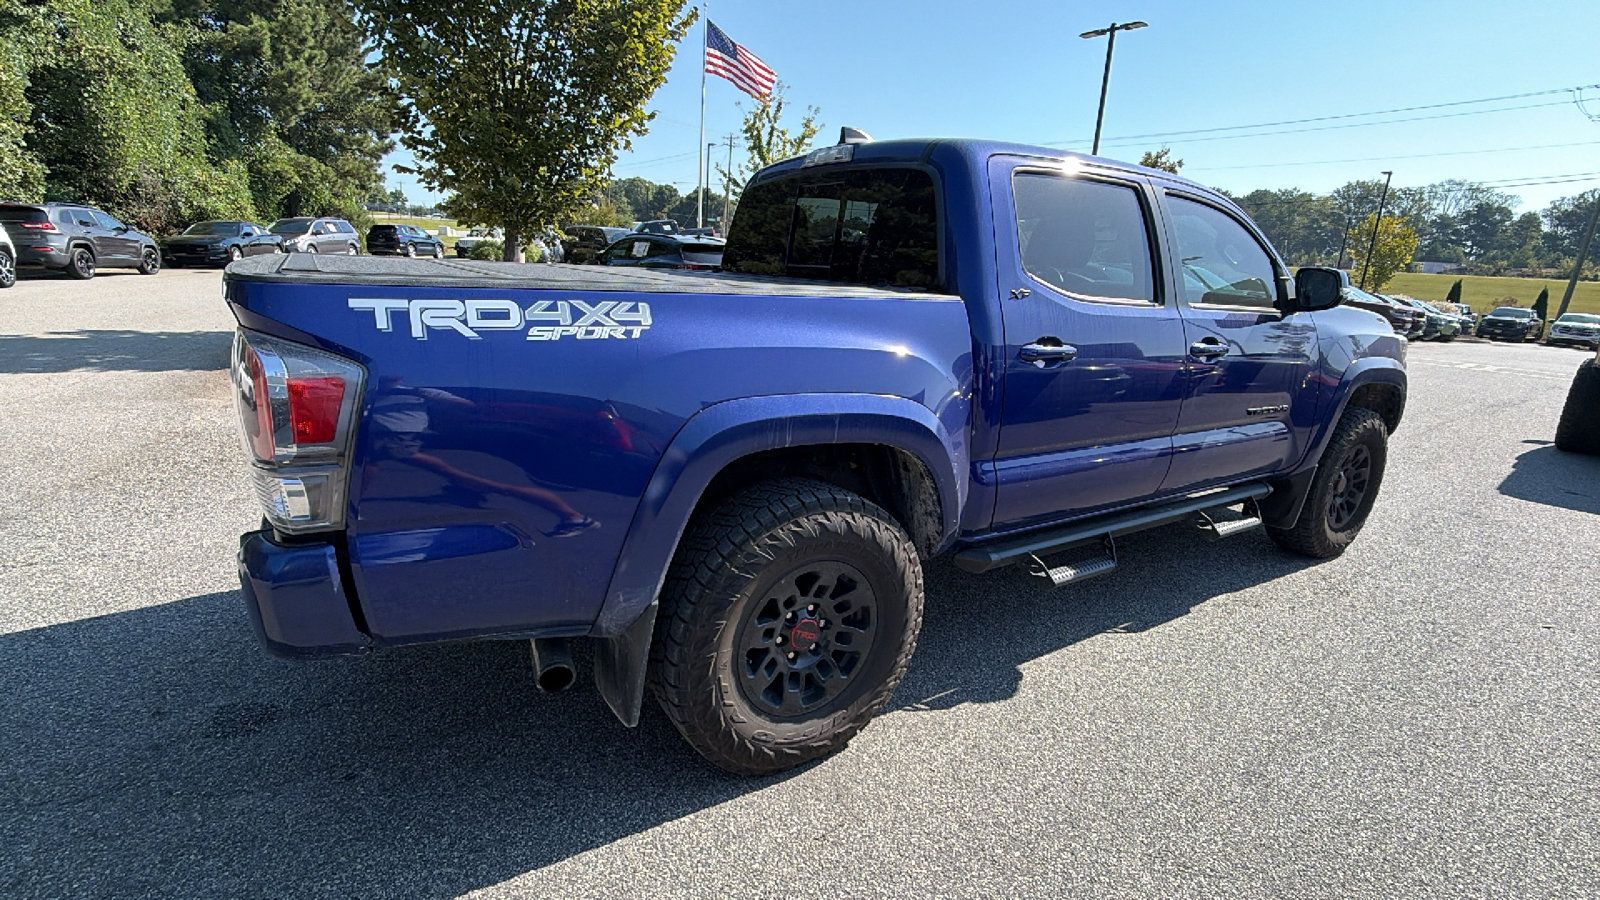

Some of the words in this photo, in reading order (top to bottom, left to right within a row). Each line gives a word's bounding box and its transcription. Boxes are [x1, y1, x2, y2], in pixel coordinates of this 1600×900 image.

[1008, 288, 1031, 300] XP
[347, 298, 525, 341] TRD
[526, 325, 650, 341] SPORT
